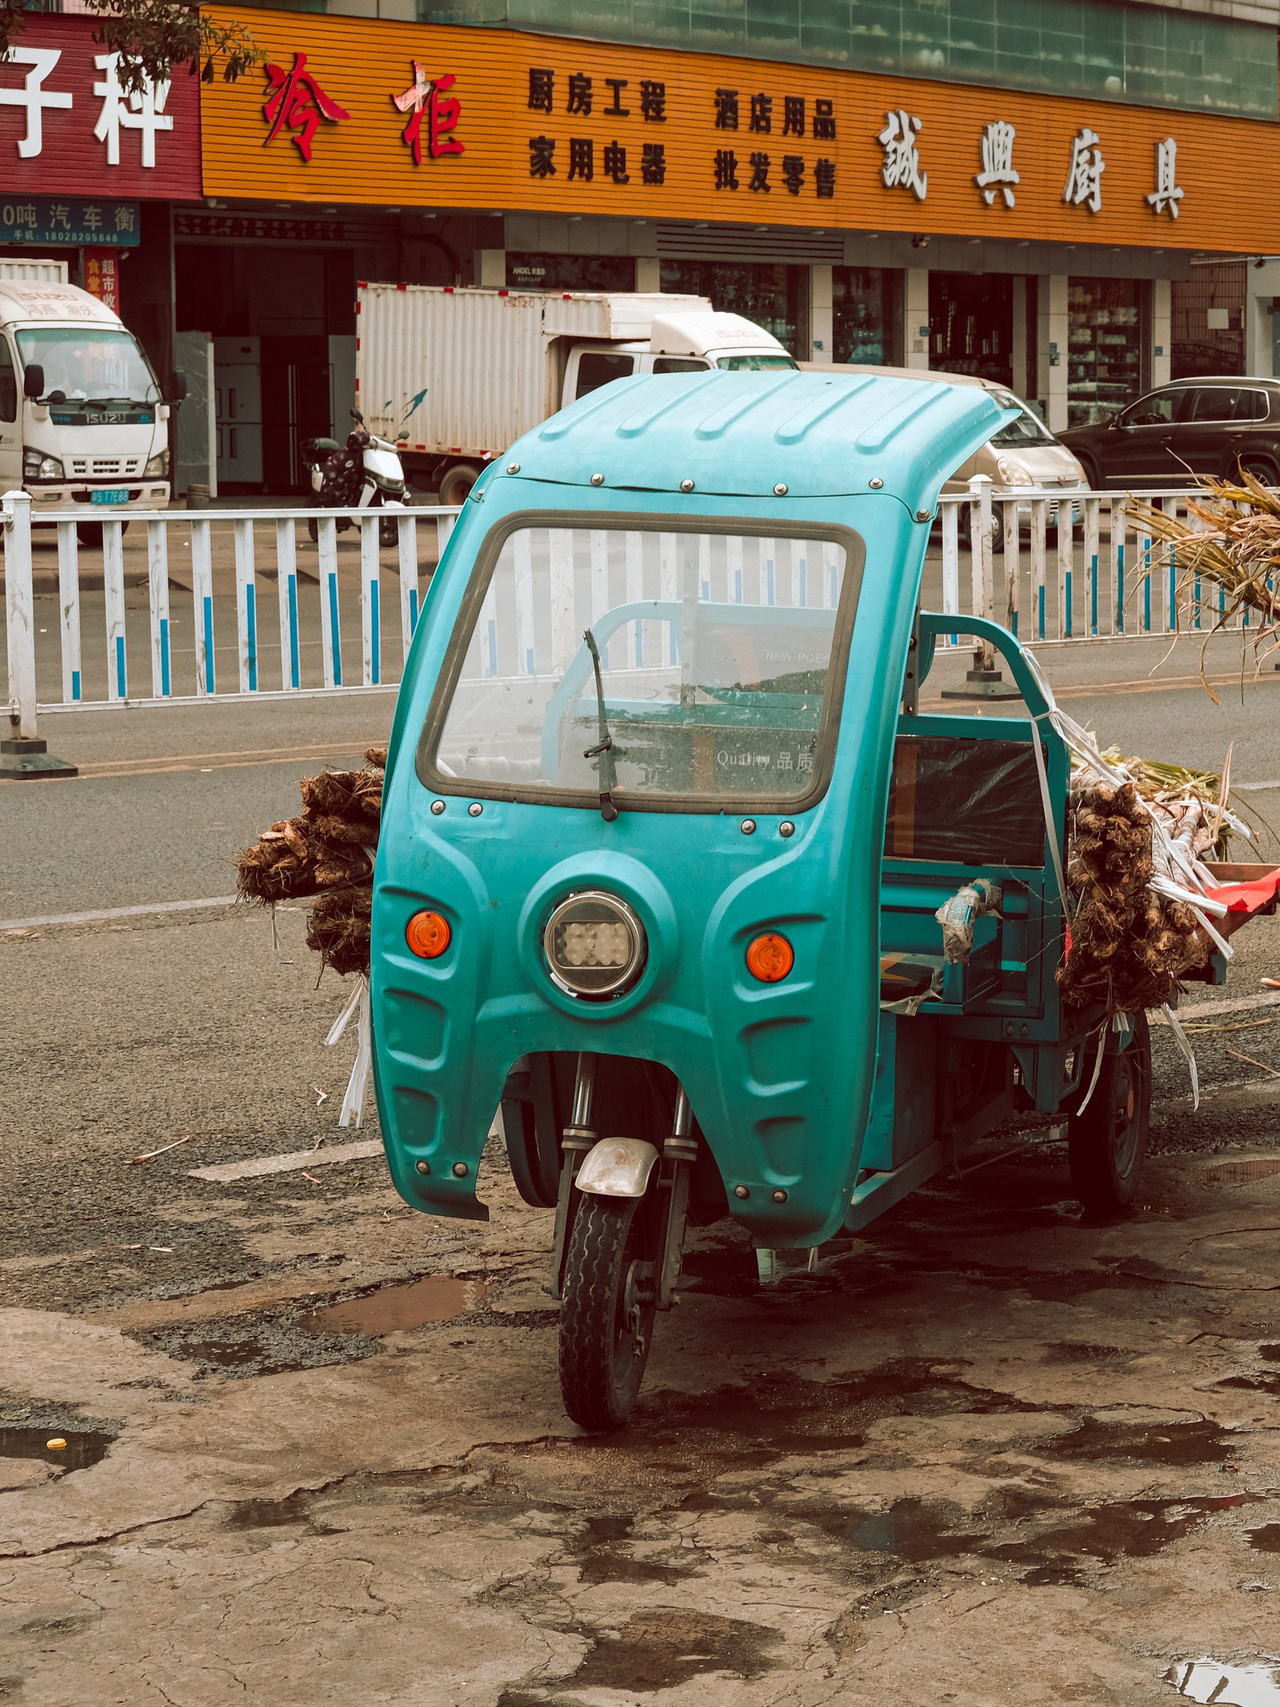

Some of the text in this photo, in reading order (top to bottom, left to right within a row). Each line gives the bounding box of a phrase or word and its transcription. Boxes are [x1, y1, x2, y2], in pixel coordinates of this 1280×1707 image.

[0, 46, 174, 168] 子秤
[263, 52, 466, 166] 冷柜
[528, 67, 837, 140] 厨房工程 酒店用品
[528, 135, 837, 199] 家用电器 批发零售
[86, 413, 127, 424] ISUZU
[765, 651, 791, 661] NEW
[717, 750, 814, 772] Quality 品质
